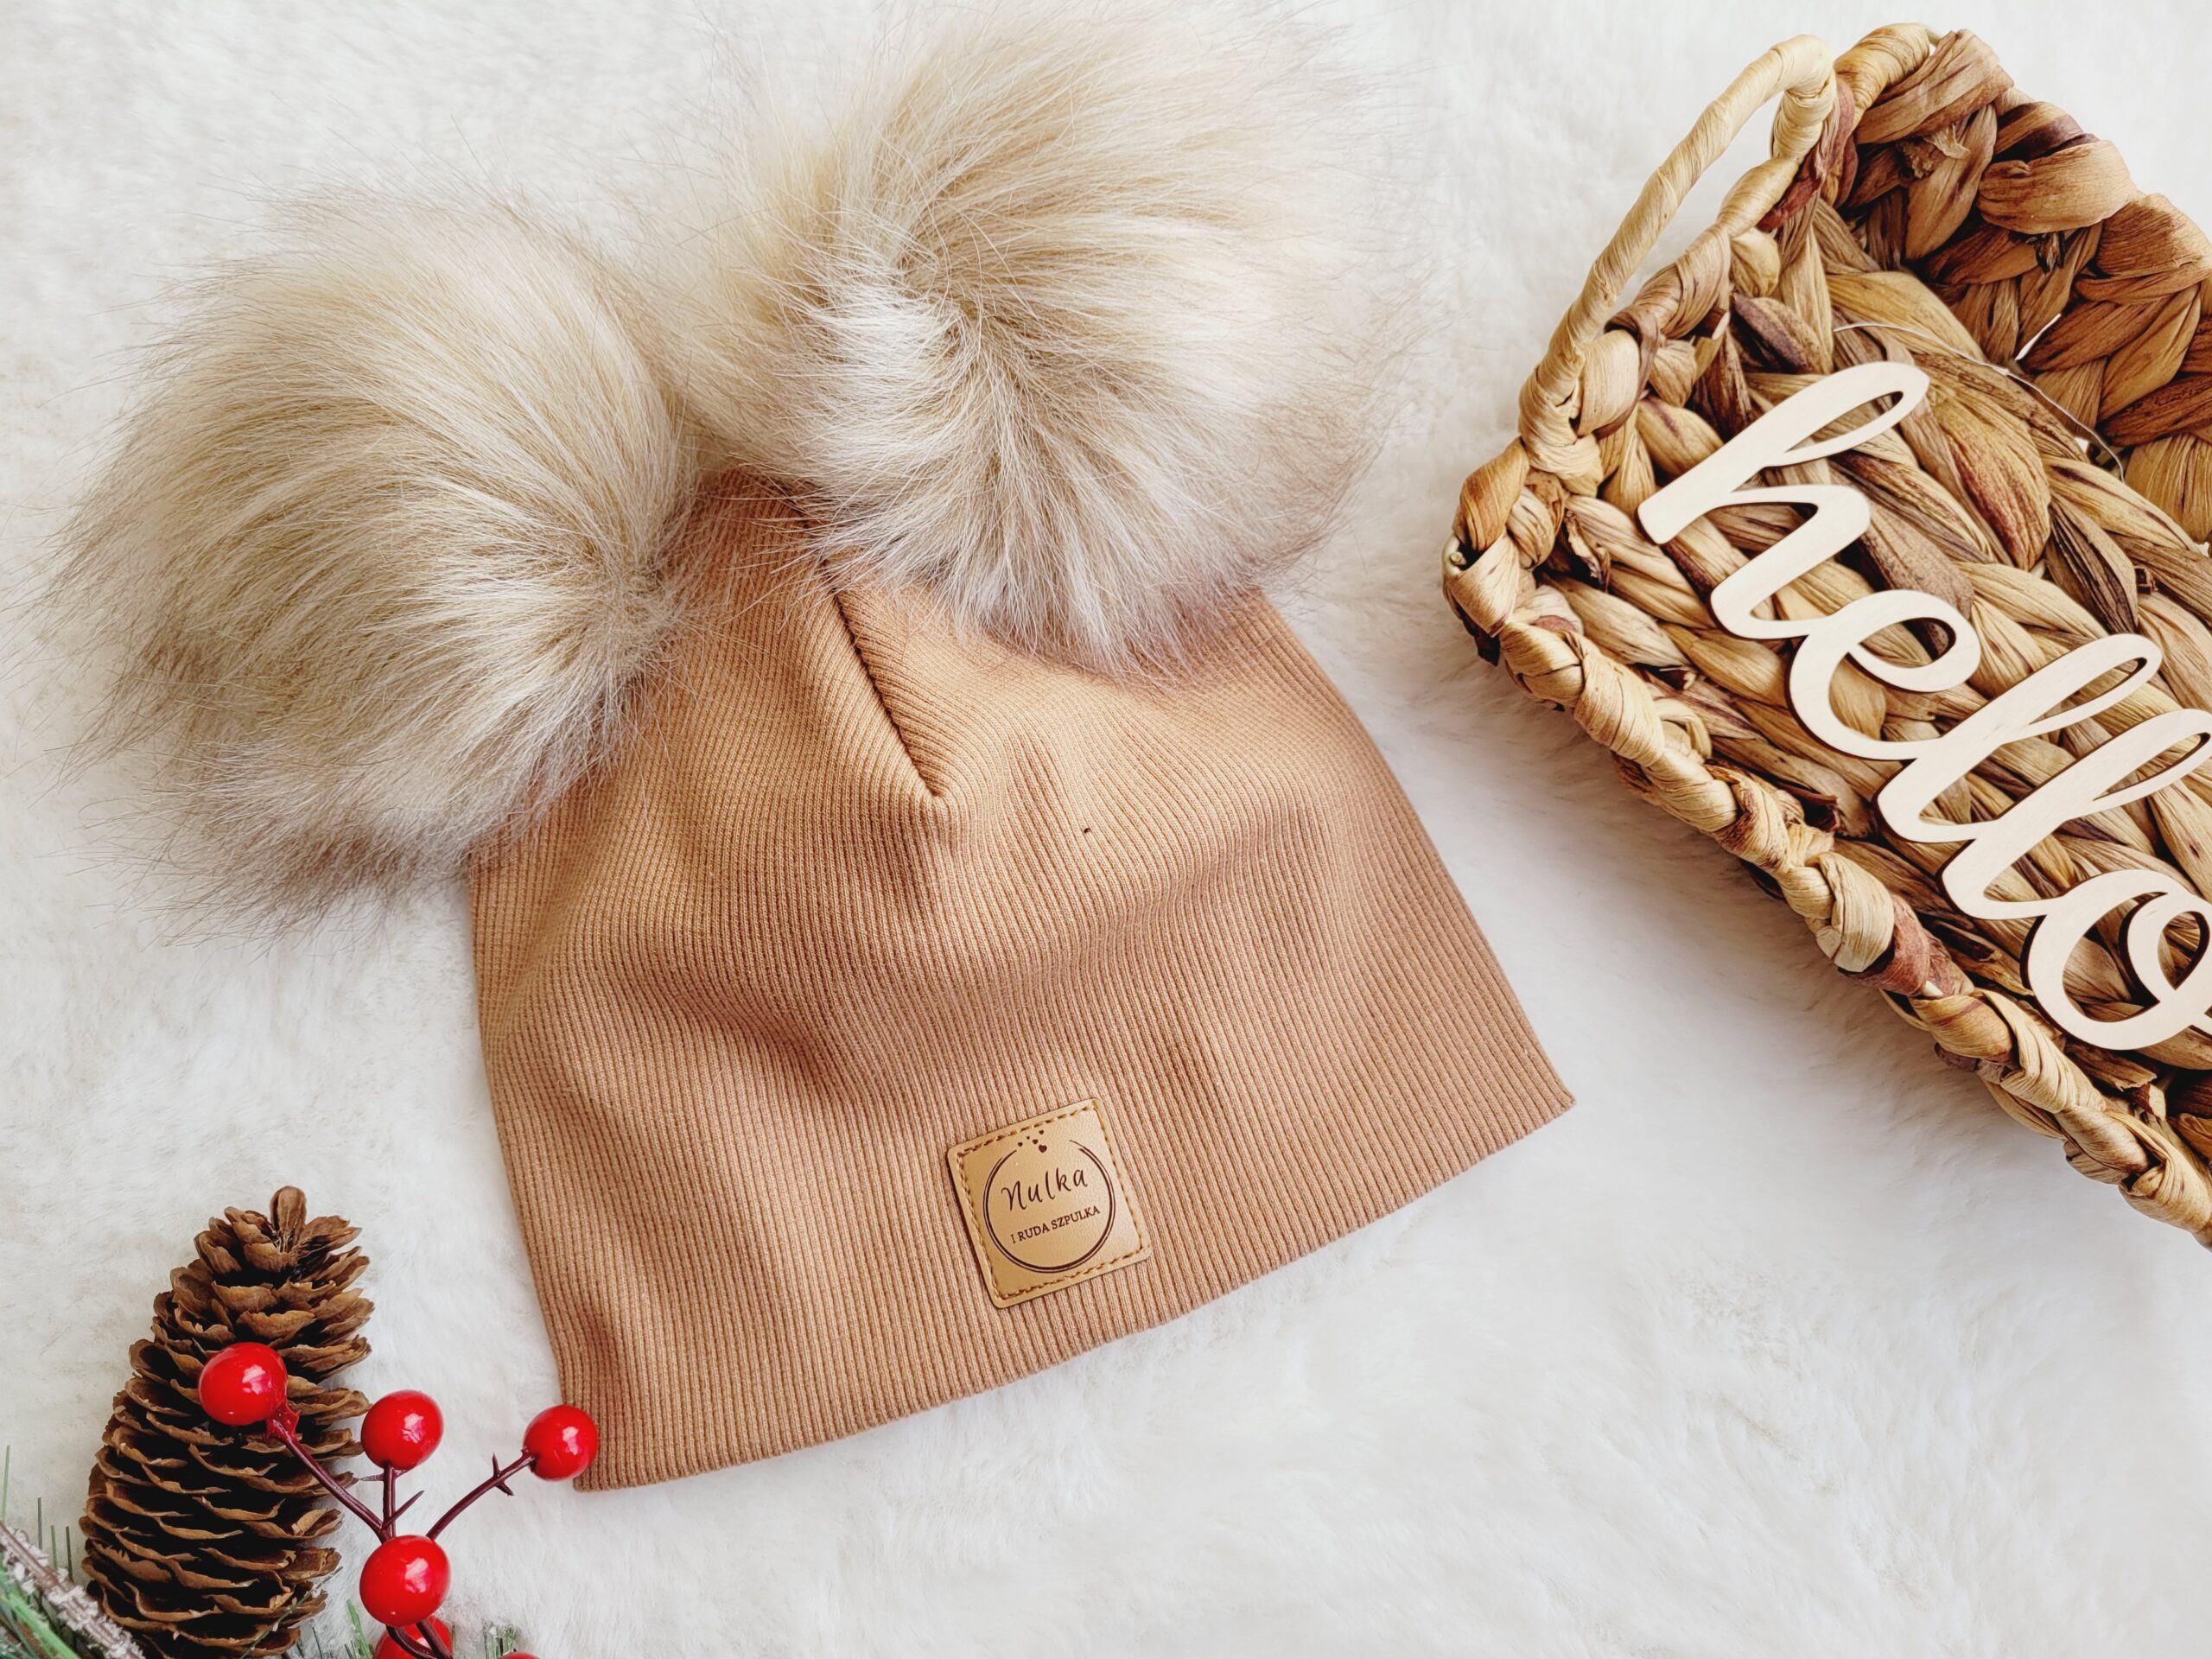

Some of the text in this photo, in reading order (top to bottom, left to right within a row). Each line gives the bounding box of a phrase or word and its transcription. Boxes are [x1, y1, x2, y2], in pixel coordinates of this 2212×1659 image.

[1638, 361, 2212, 1050] hello
[1001, 1167, 1088, 1211] Nulka
[1010, 1205, 1101, 1243] I RUDA SZPULKA
